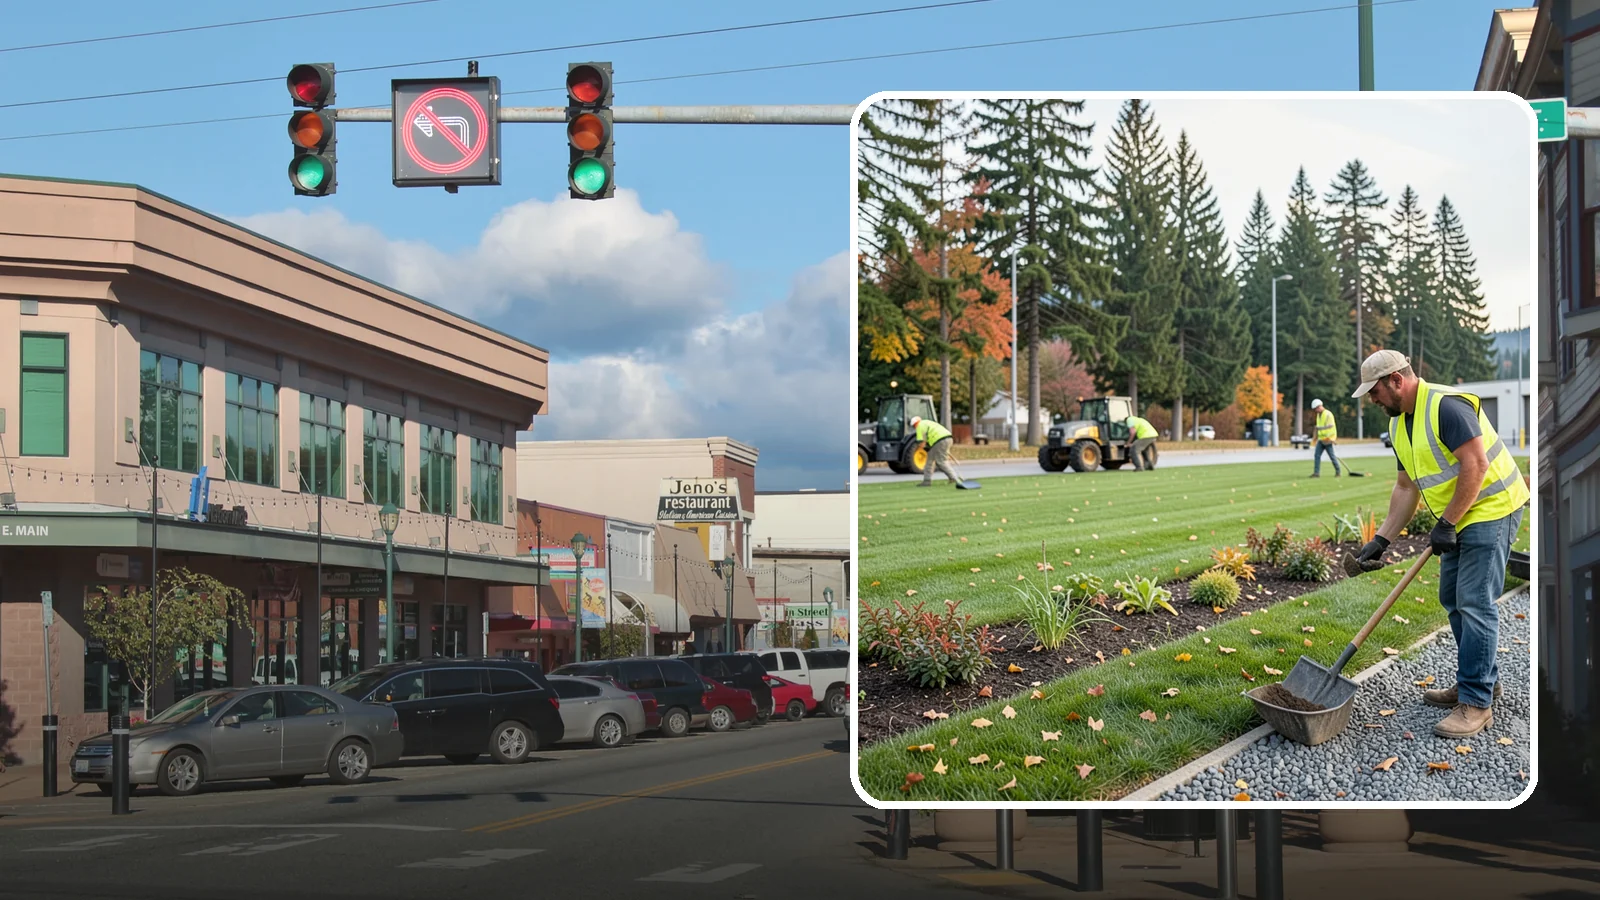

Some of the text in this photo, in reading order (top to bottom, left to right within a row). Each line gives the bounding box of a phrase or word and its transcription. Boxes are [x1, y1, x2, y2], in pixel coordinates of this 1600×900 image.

[670, 480, 727, 494] Jeno's
[665, 496, 731, 509] restaurant
[658, 510, 681, 520] Italian
[686, 510, 714, 519] American
[715, 509, 737, 520] Cuisine
[2, 525, 49, 536] E. MAIN
[797, 607, 828, 616] Street
